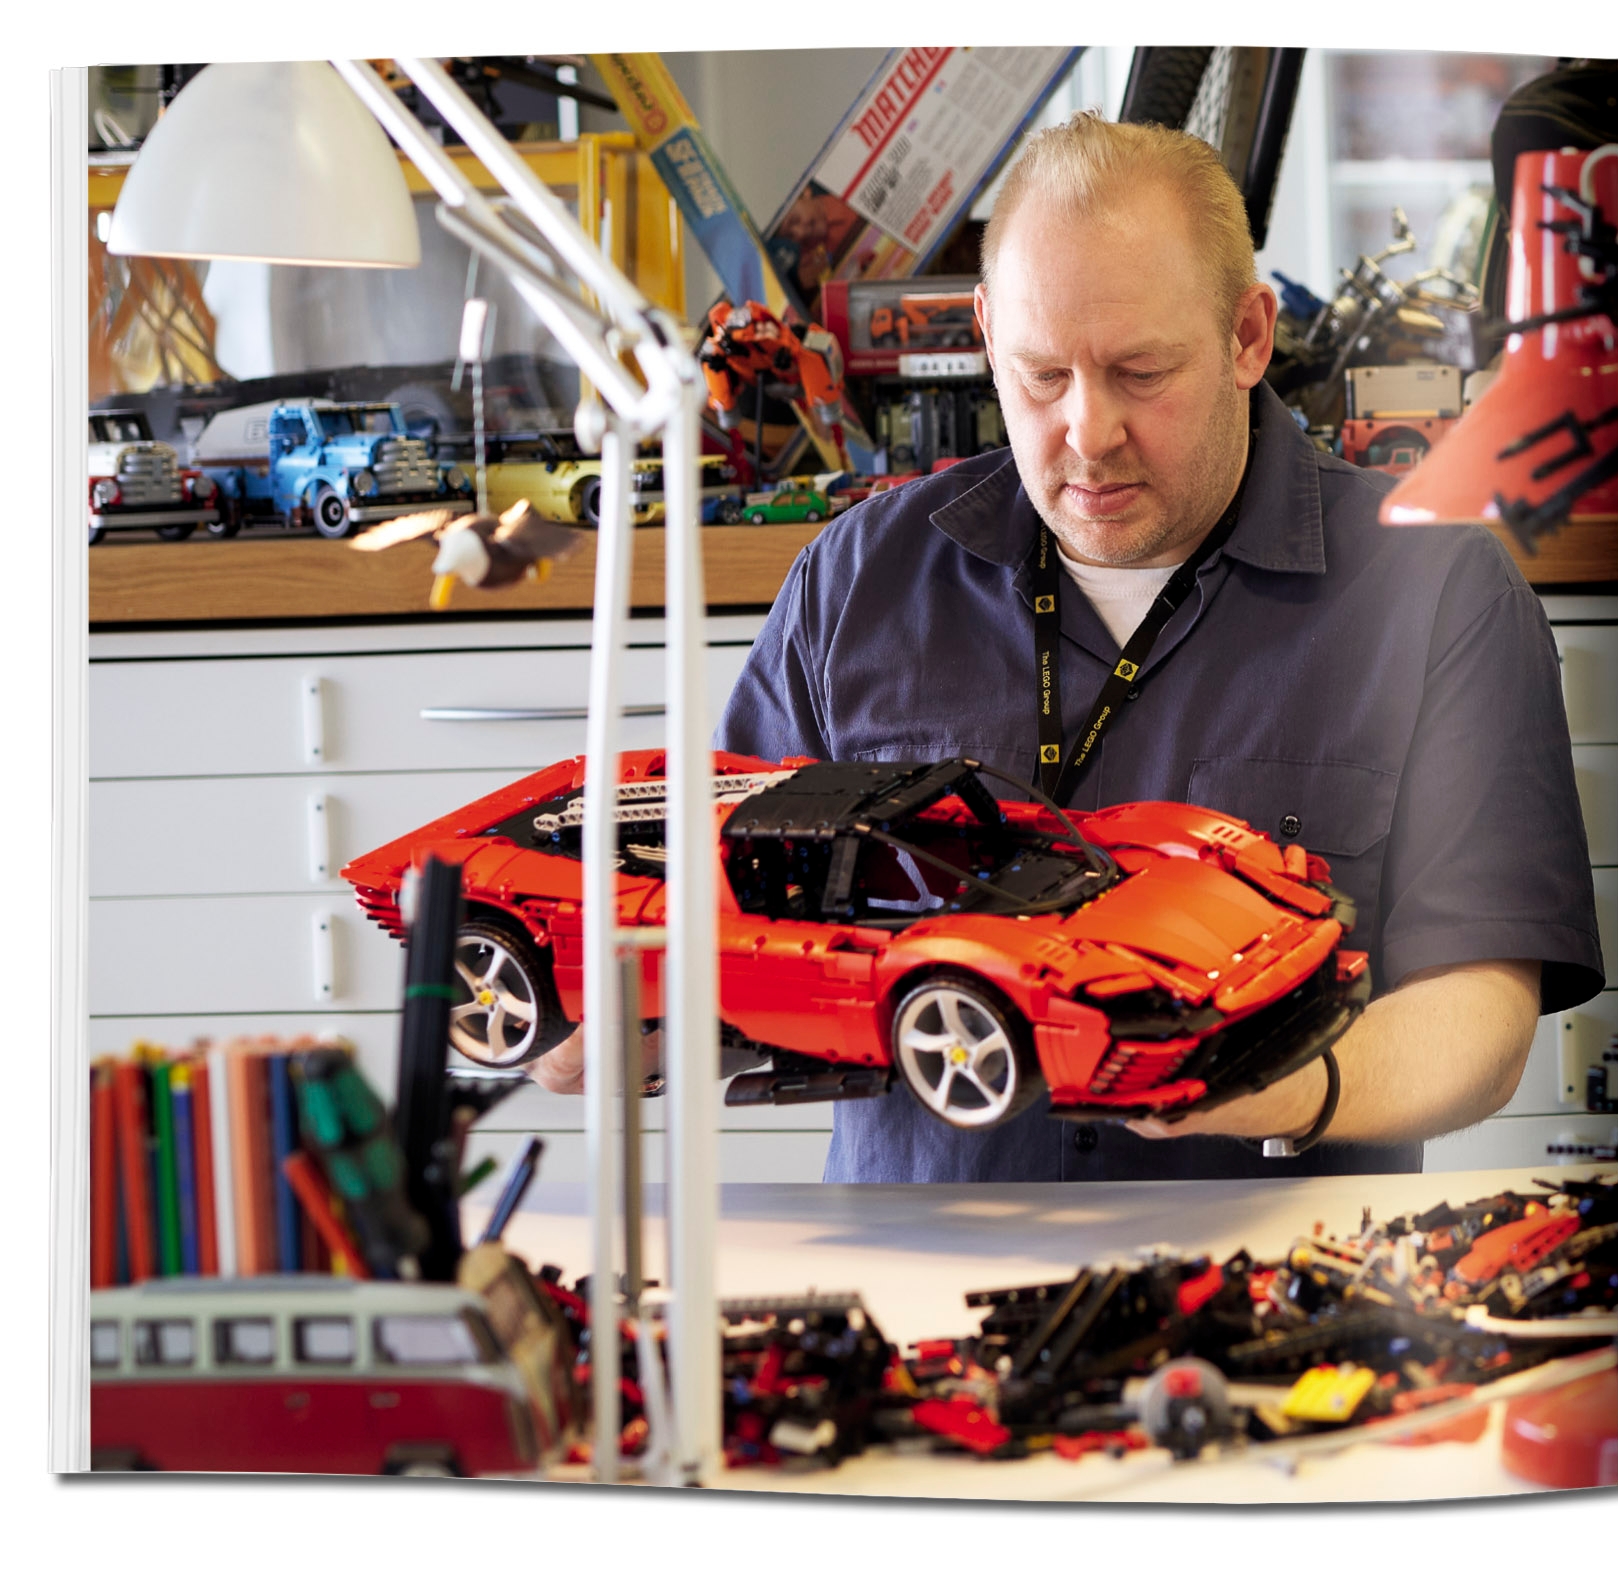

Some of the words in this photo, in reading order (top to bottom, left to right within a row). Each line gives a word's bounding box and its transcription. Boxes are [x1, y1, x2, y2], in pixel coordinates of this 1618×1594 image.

[1042, 650, 1050, 665] The
[1042, 666, 1051, 688] LEGO
[1042, 689, 1051, 715] Group
[1074, 753, 1086, 767] The
[1082, 730, 1098, 753] LEGO
[1093, 706, 1112, 730] Group
